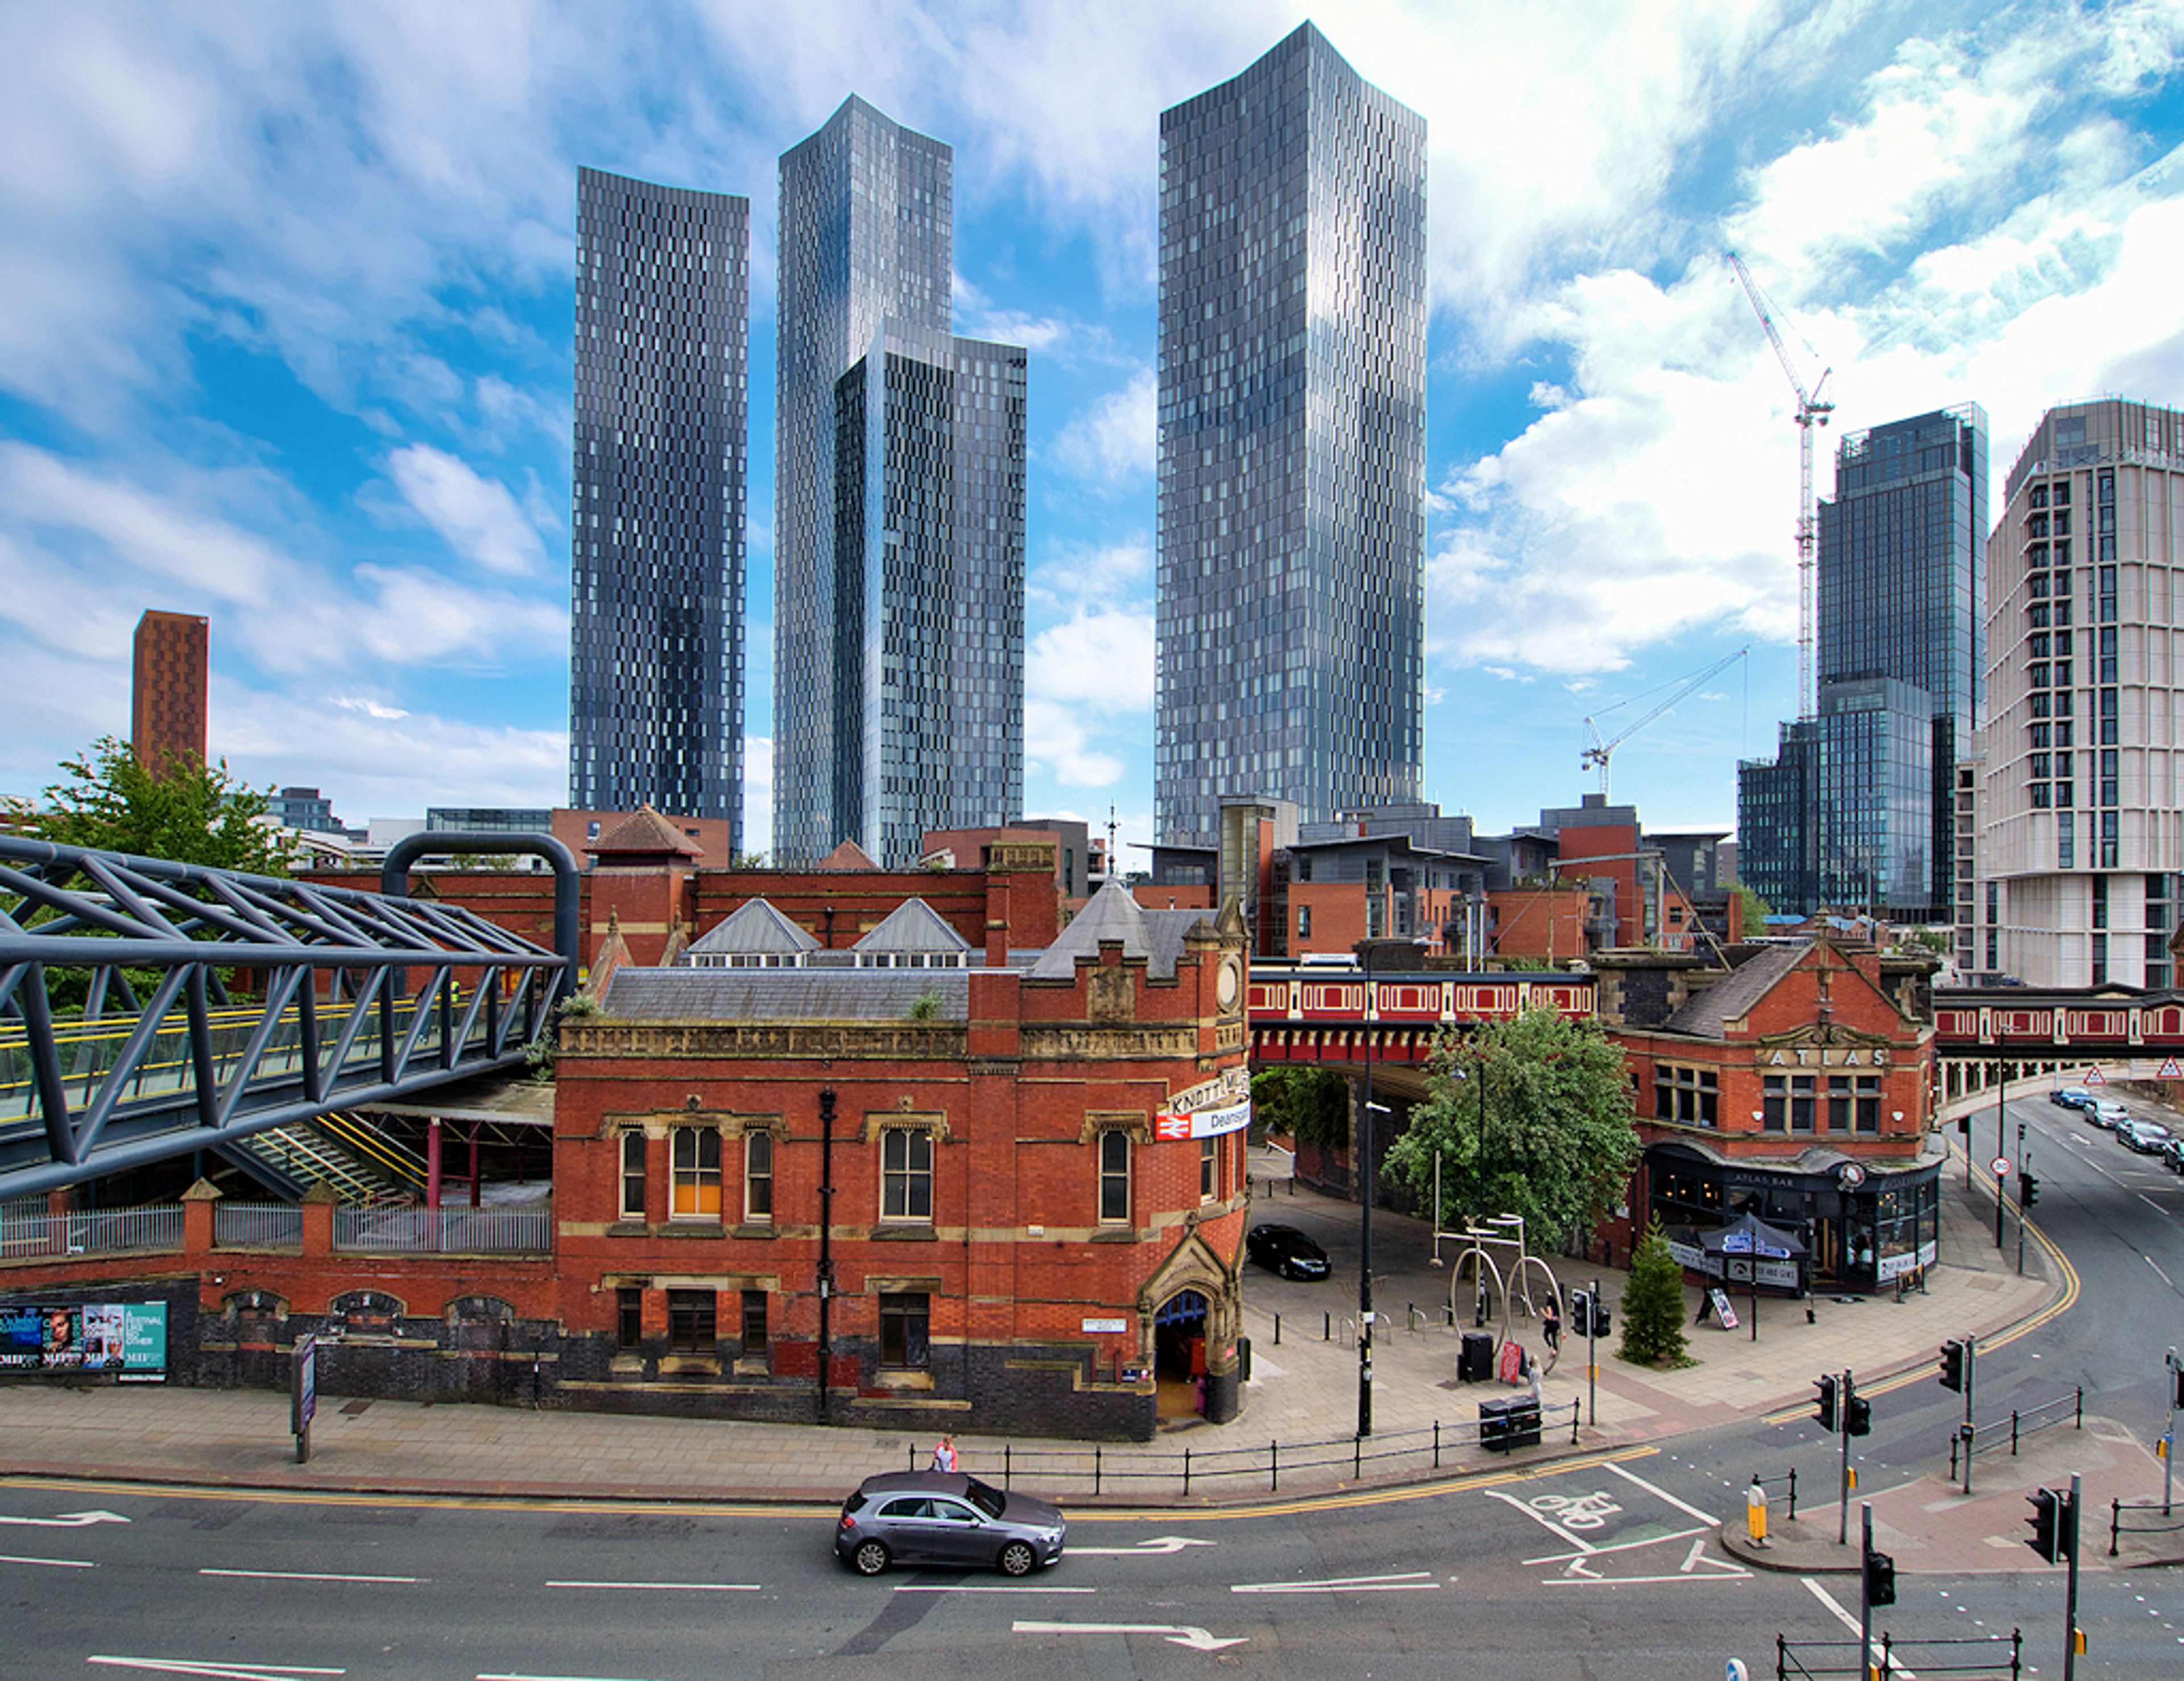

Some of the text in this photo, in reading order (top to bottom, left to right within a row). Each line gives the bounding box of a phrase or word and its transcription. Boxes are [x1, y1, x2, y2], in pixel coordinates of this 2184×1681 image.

[1770, 1050, 1884, 1065] ATLAS
[1173, 1083, 1219, 1113] KNOTT
[1211, 1108, 1248, 1128] Deansg
[1734, 1174, 1769, 1184] ATLAS
